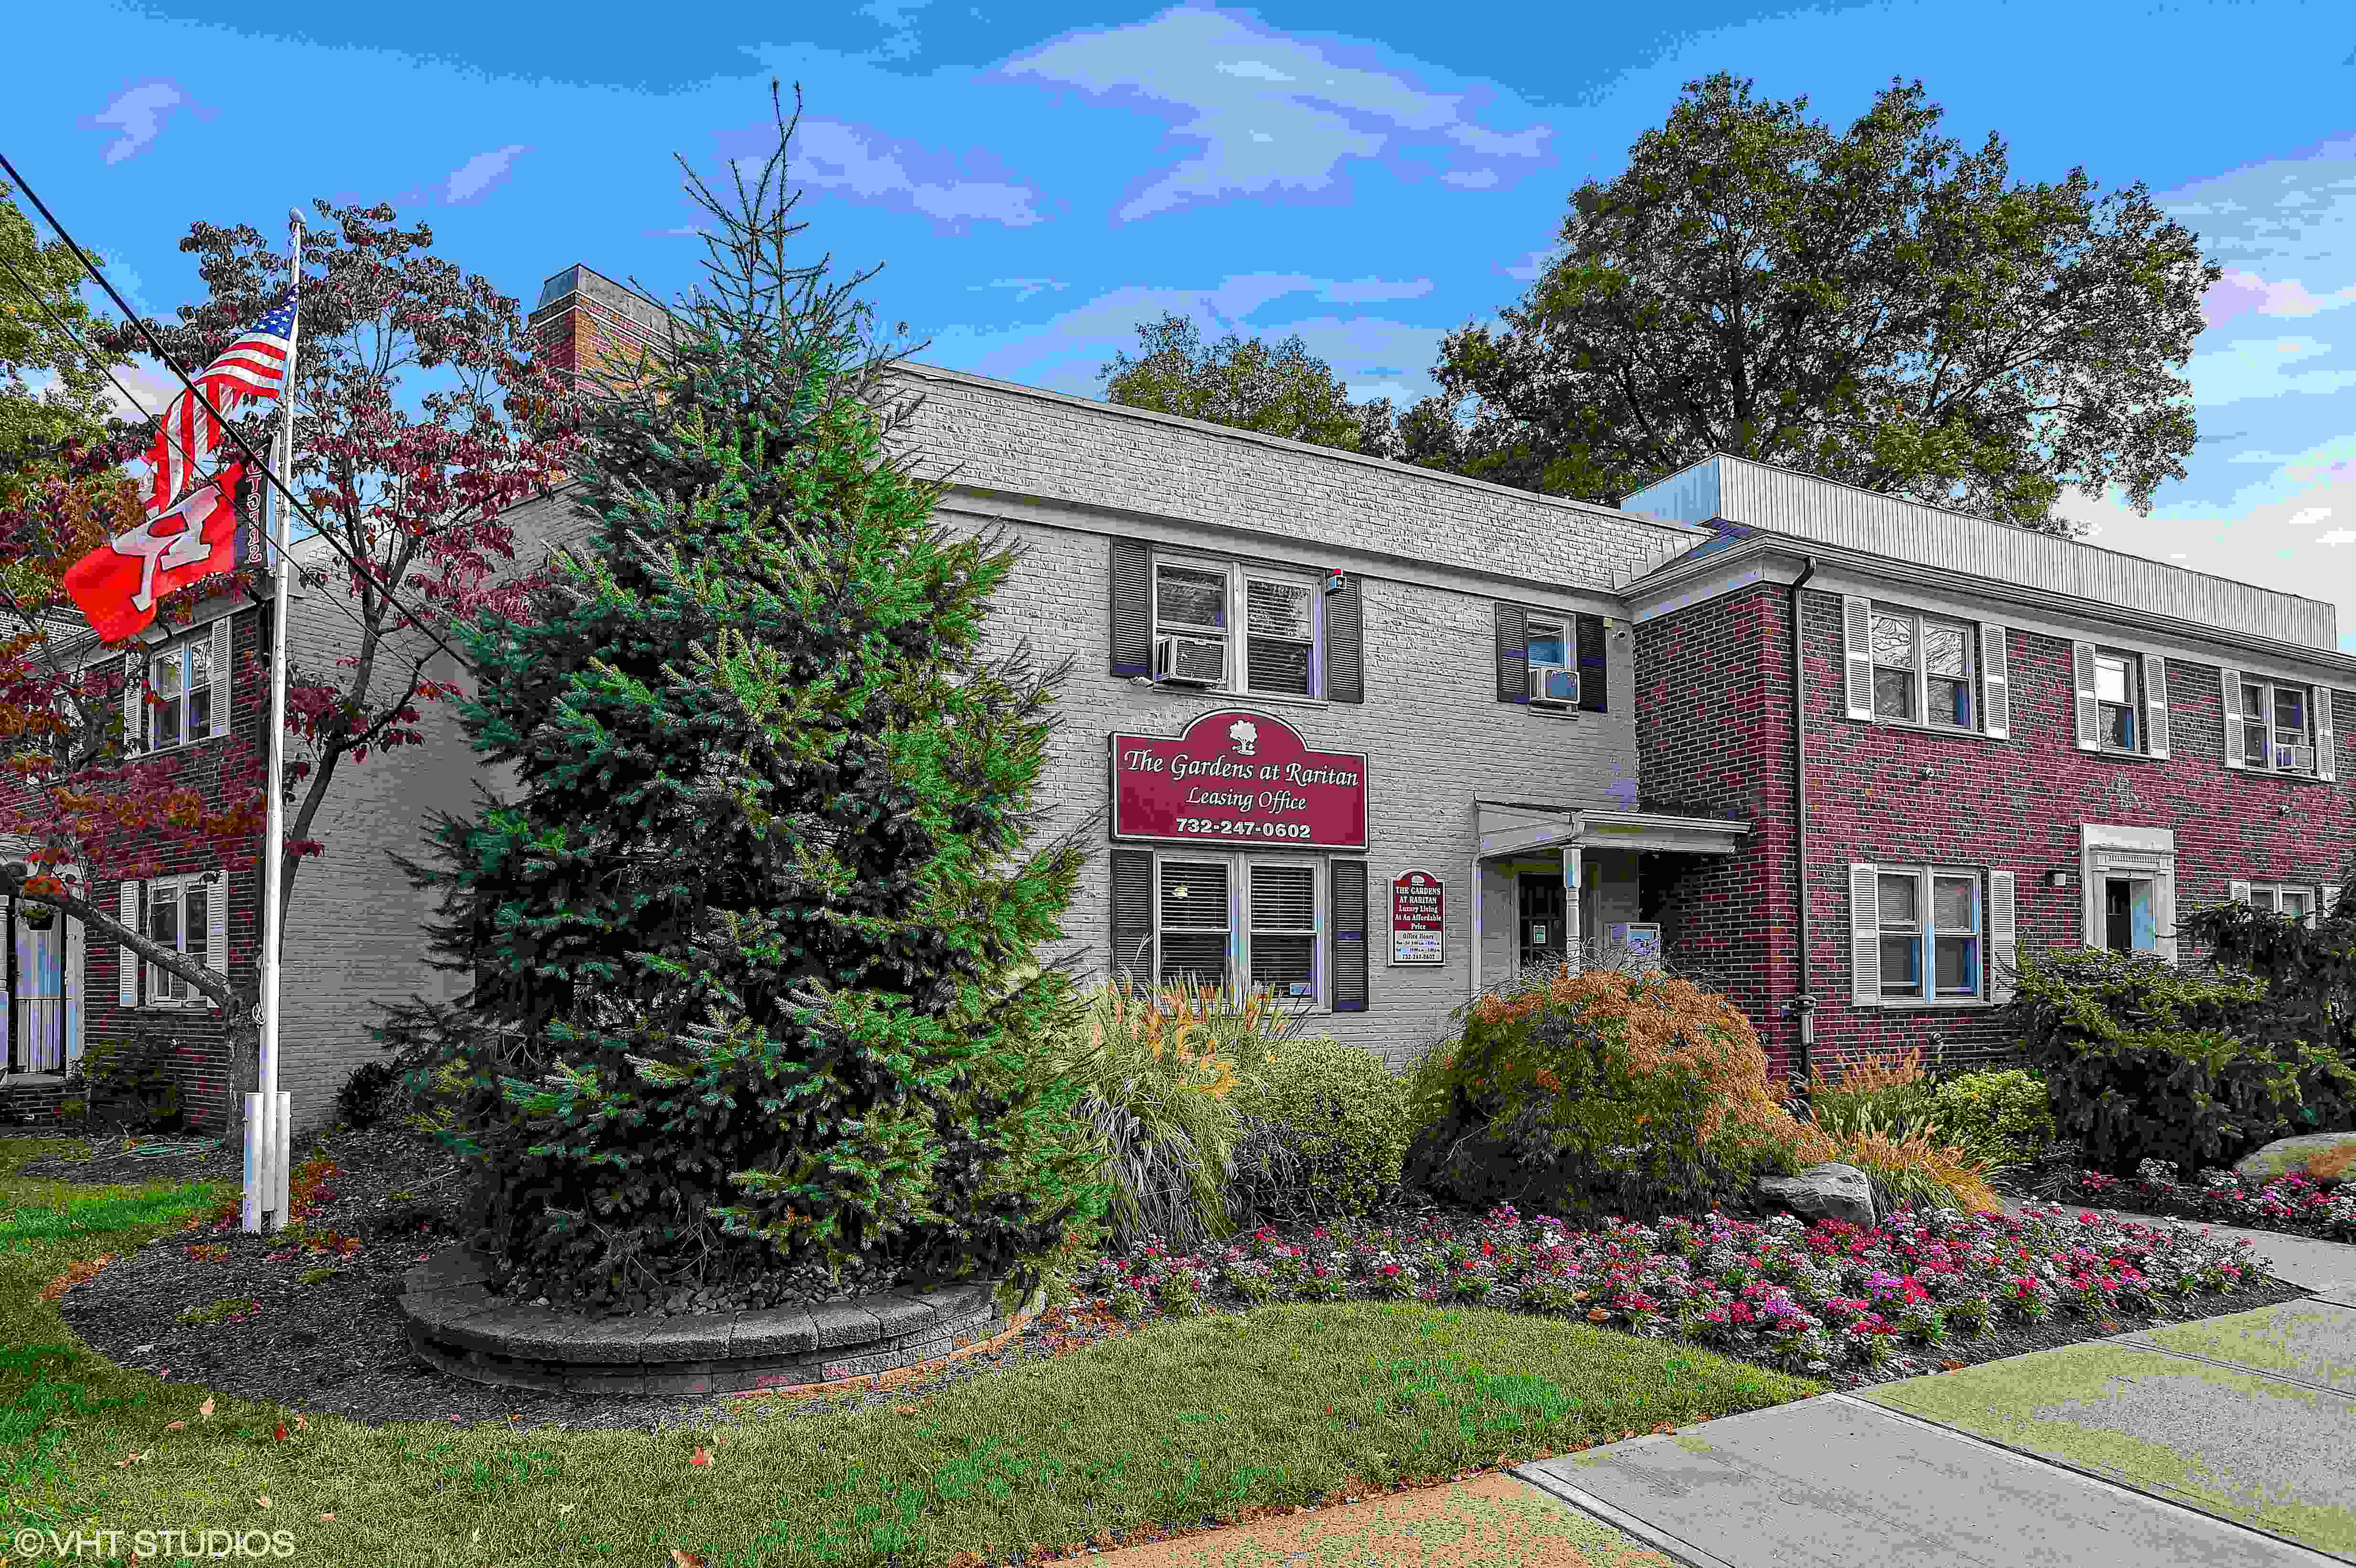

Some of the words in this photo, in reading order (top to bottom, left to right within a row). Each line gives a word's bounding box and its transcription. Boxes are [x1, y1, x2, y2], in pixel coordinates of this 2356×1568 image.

[1124, 748, 1164, 773] The
[1171, 755, 1253, 781] Gardens
[1260, 763, 1281, 780] at
[1285, 762, 1359, 787] Raritan
[1186, 786, 1254, 812] Leasing
[1258, 790, 1307, 814] Office
[1176, 818, 1311, 838] 732-247-0602
[1396, 886, 1409, 895] THE
[1411, 887, 1441, 895] GARDENS
[1420, 905, 1437, 914] Living
